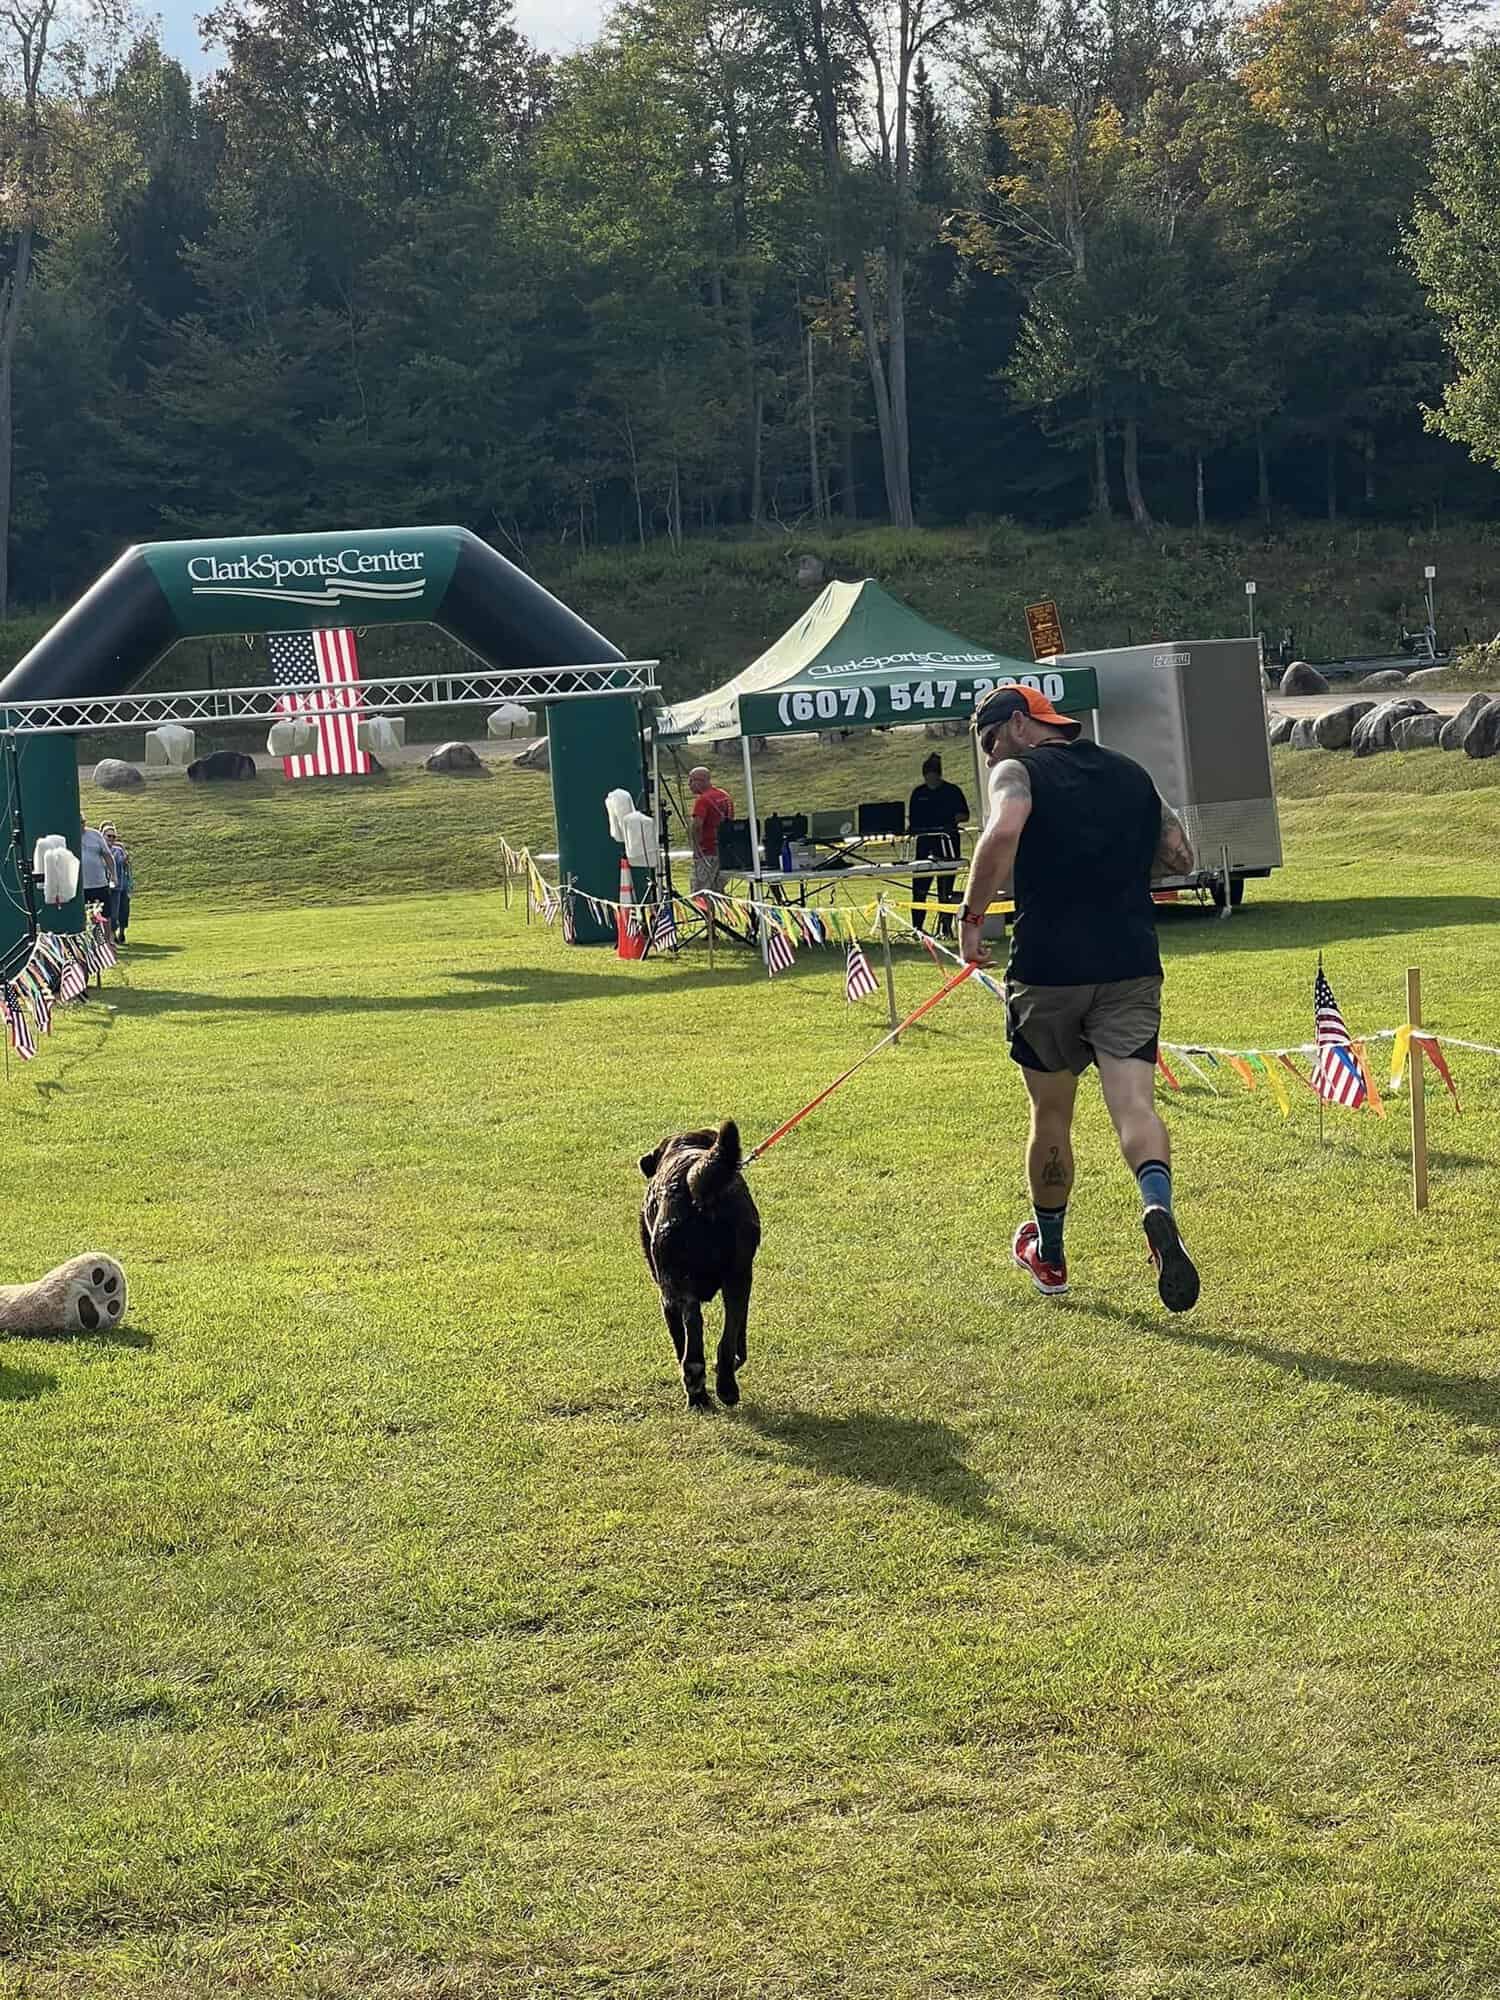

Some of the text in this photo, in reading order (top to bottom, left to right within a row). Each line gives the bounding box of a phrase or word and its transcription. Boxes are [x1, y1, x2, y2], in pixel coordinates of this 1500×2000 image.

[187, 549, 425, 587] ClarkSportsCenter
[808, 651, 997, 677] ClarkSportsCenter
[778, 686, 876, 727] (607)
